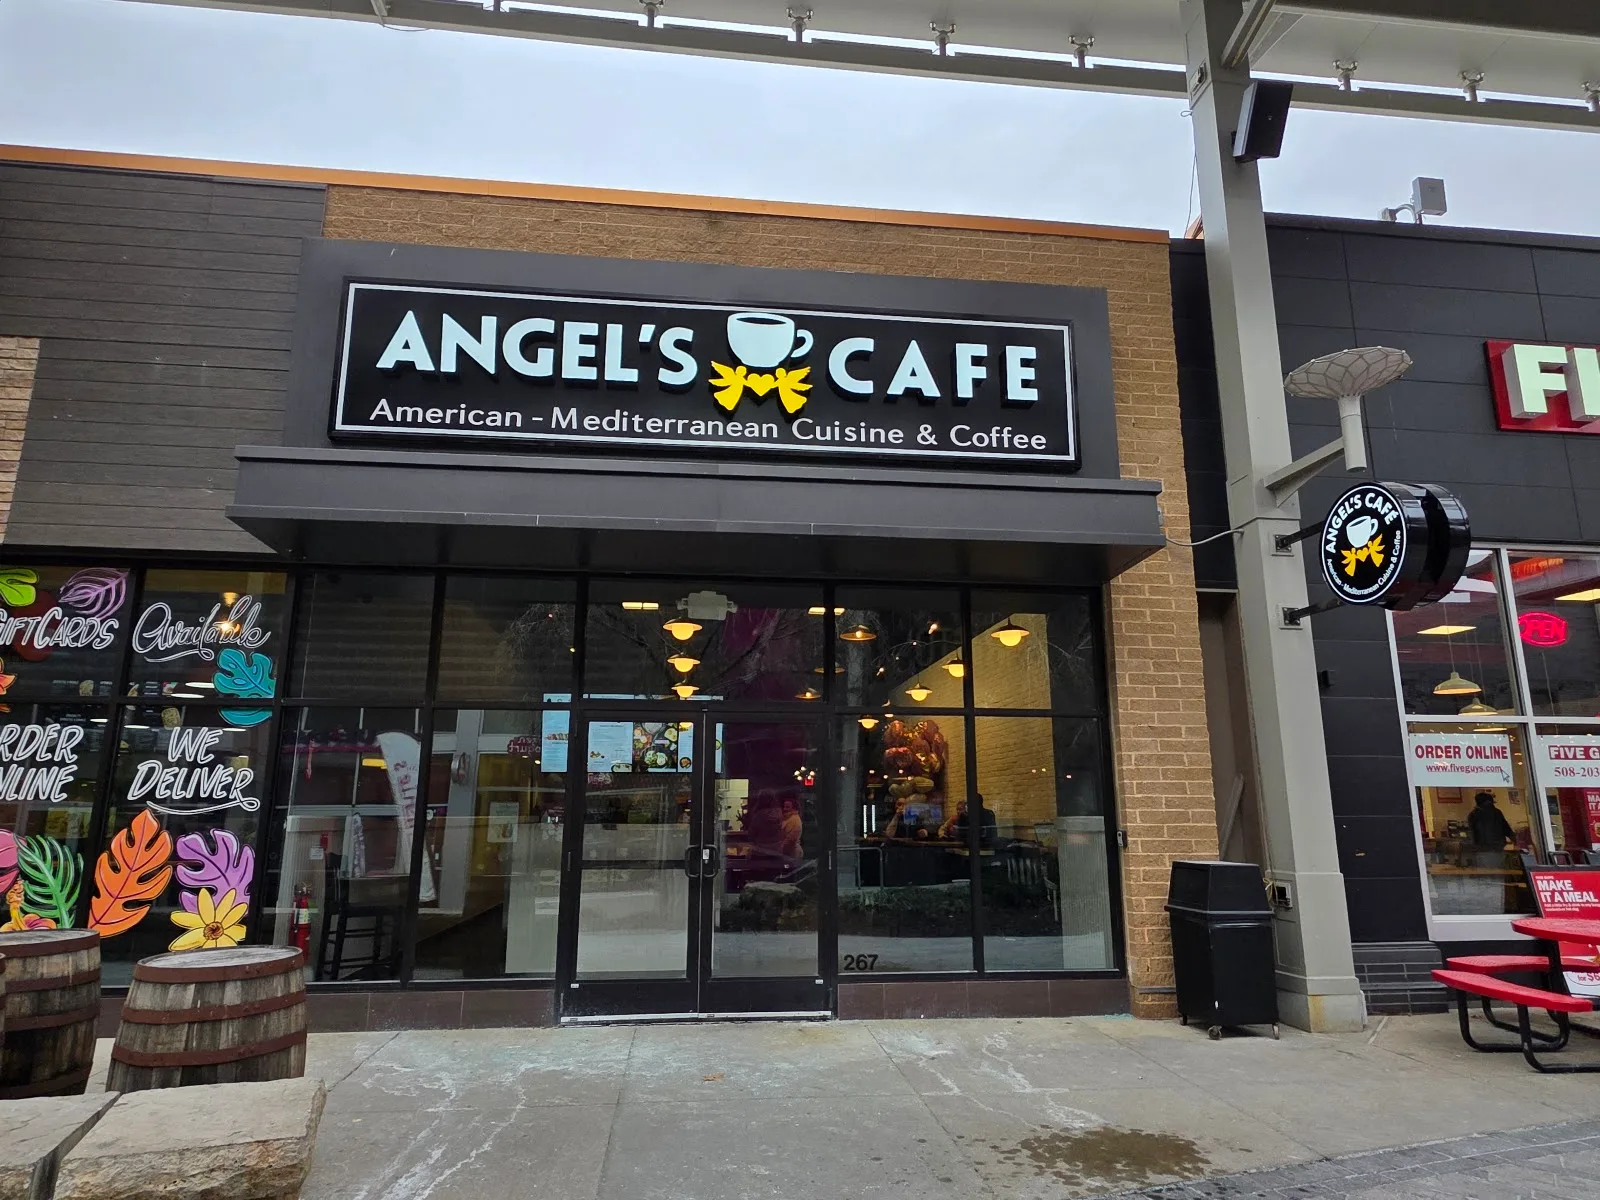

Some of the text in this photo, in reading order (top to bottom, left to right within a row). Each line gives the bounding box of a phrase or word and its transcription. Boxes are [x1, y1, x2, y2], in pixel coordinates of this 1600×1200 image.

[375, 309, 1039, 401] ANGEL'S CAFE
[370, 398, 522, 427] American
[551, 406, 778, 439] Mediterranean
[792, 418, 904, 444] Cuisine
[916, 424, 938, 446] &
[950, 424, 1047, 450] Coffee
[1325, 492, 1399, 553] ANGEL'S CAFE
[1392, 530, 1401, 556] Coffee
[1390, 556, 1398, 564] &
[1378, 563, 1395, 585] Cuisine
[132, 595, 271, 661] Available
[168, 727, 223, 764] WE
[1415, 744, 1508, 759] ORDER ONLINE
[1550, 747, 1586, 759] FIVE
[1426, 764, 1502, 774] www.fiveguys.com
[127, 760, 260, 811] DELIVER
[1536, 880, 1574, 890] MAKE
[1540, 892, 1599, 902] IT A MEAL
[843, 954, 878, 971] 267
